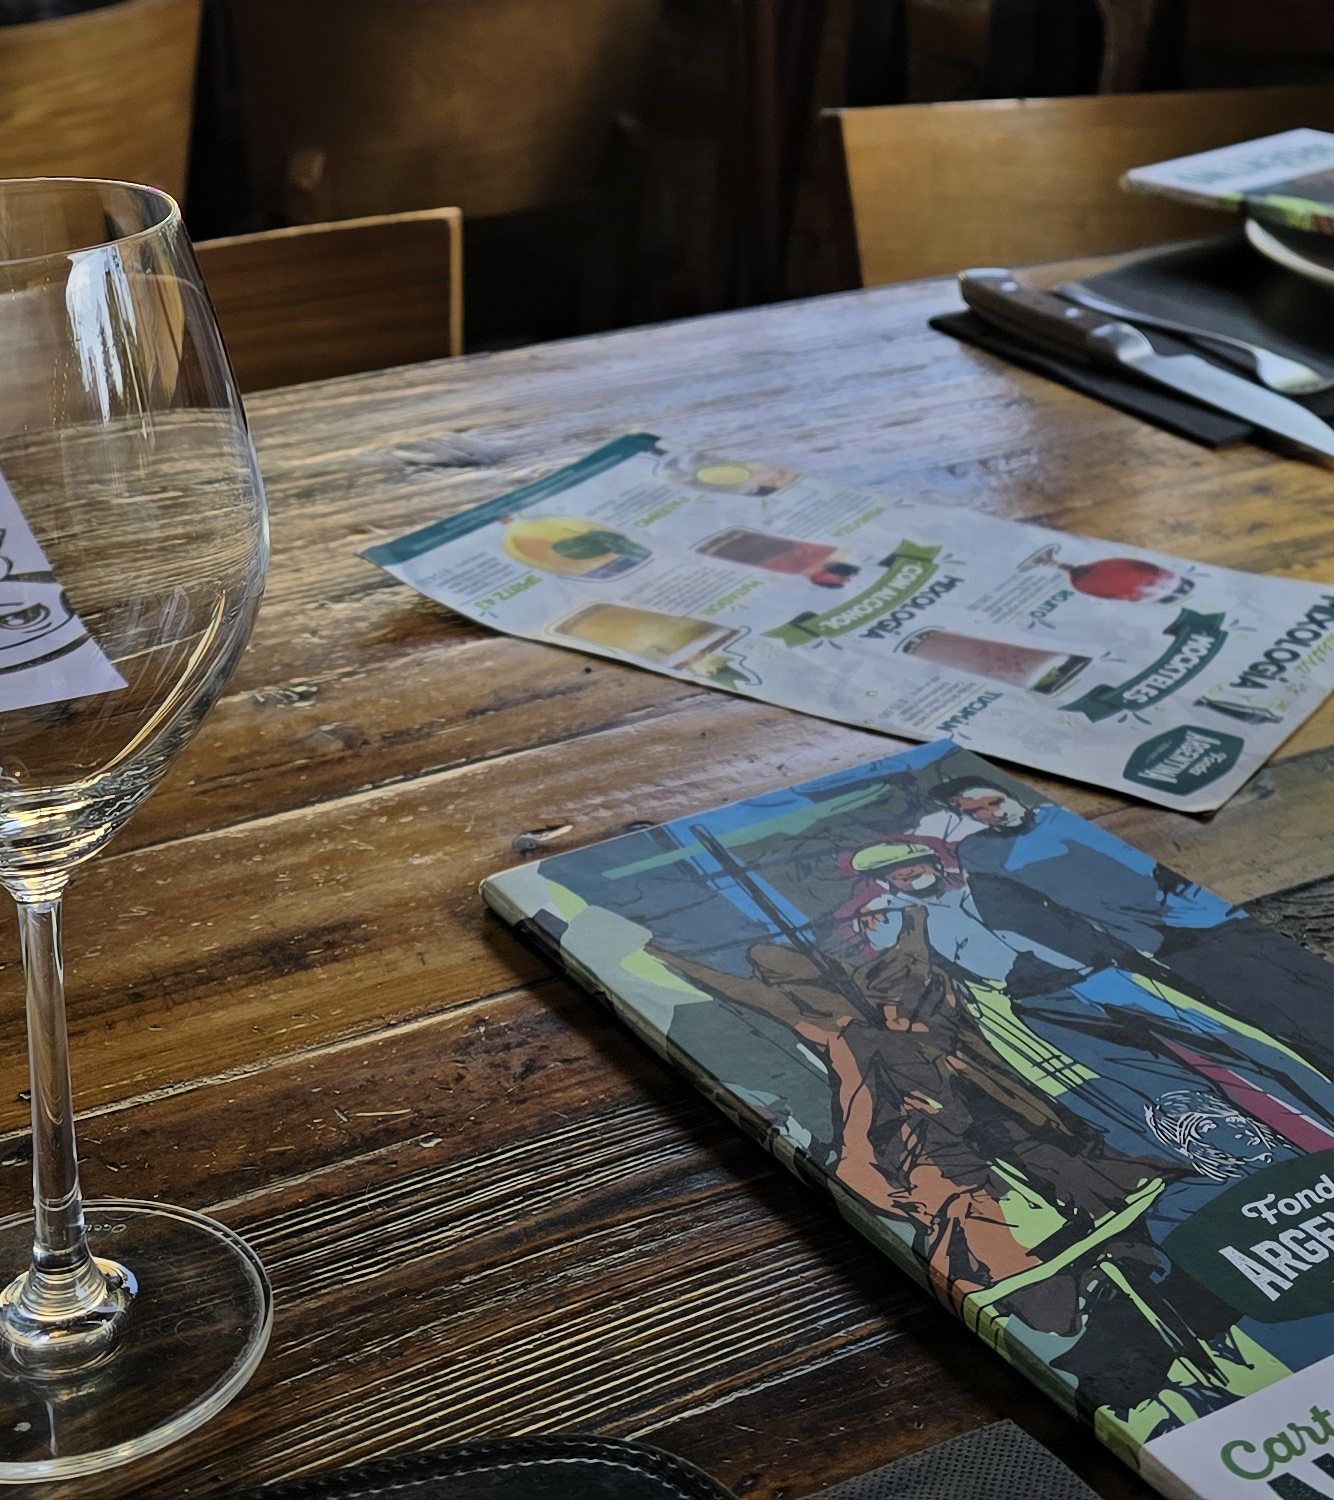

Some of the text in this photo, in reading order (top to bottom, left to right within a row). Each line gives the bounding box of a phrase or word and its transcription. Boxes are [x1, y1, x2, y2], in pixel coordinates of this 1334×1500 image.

[821, 564, 924, 630] CON ALCOHOL
[858, 575, 965, 640] MIXOLOGÍA
[1122, 634, 1215, 704] MOCKTELES
[936, 691, 1003, 732] TUCUMÁN
[1137, 731, 1221, 784] ARGENTINA
[1189, 750, 1227, 777] Fonda
